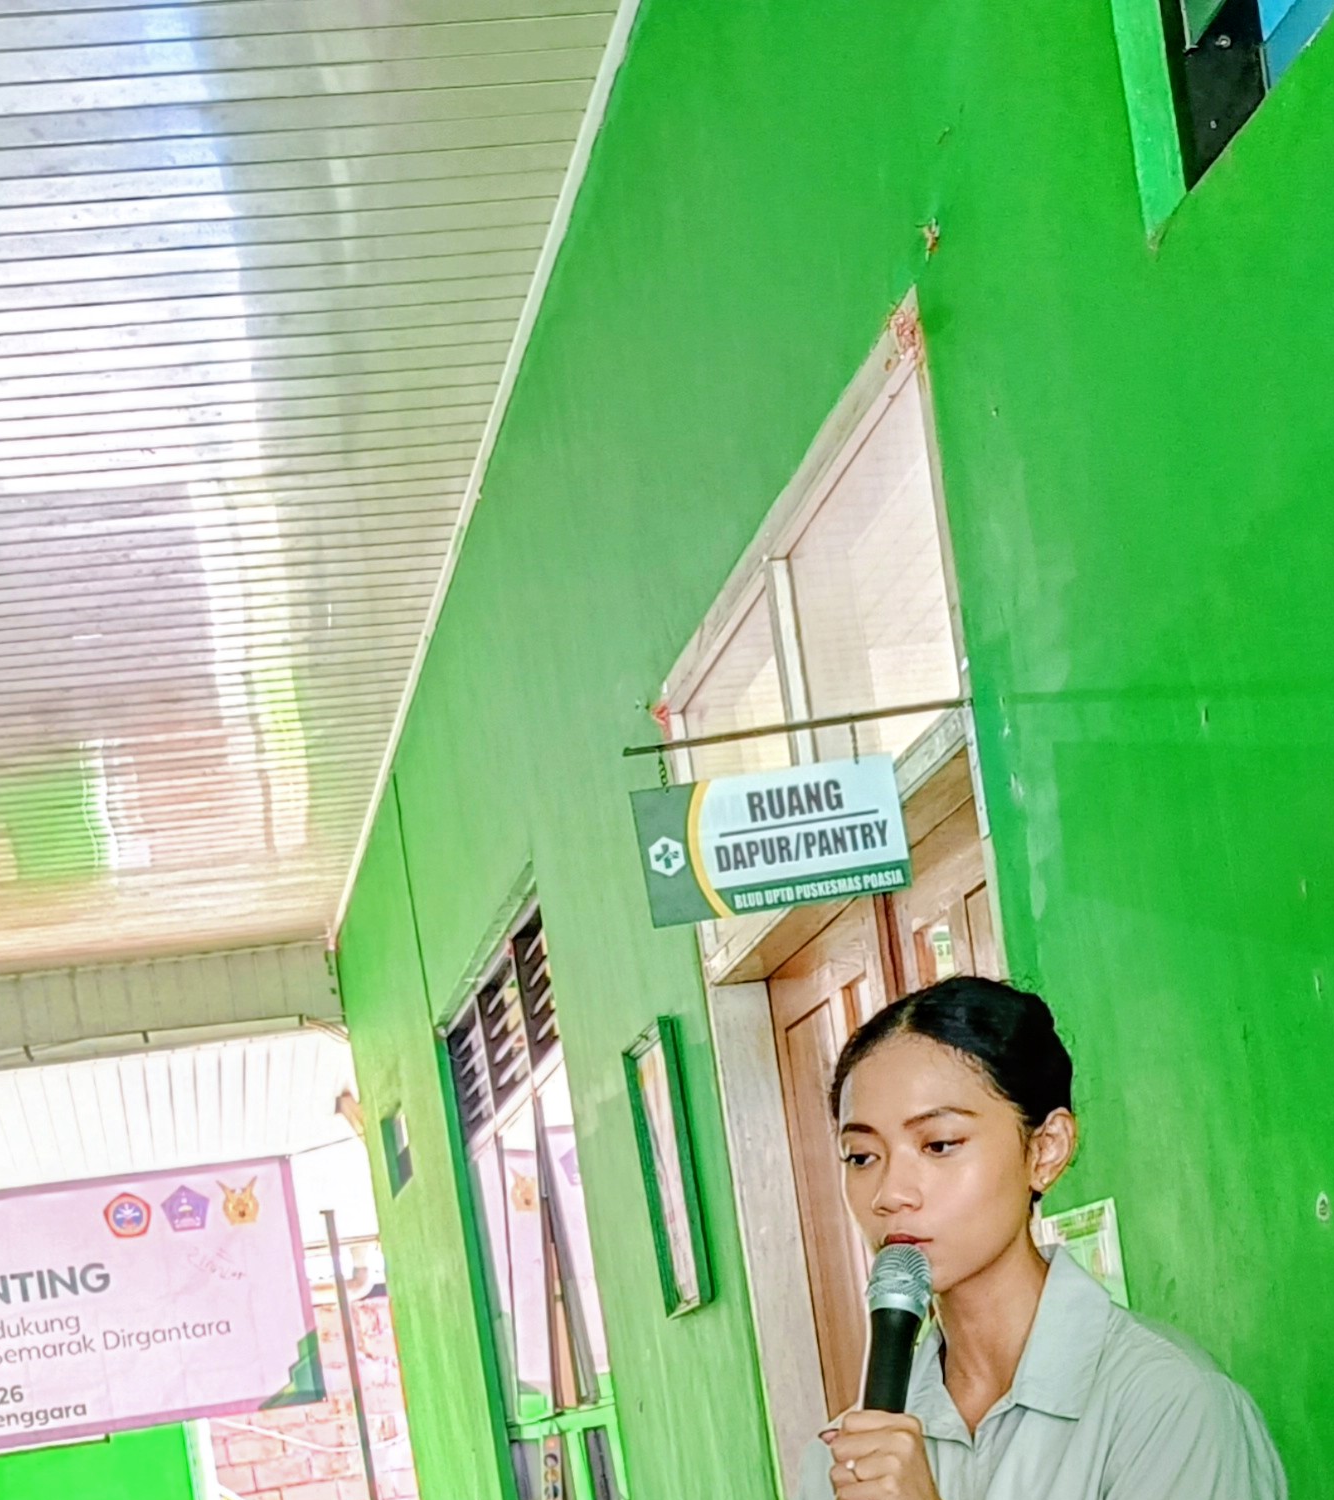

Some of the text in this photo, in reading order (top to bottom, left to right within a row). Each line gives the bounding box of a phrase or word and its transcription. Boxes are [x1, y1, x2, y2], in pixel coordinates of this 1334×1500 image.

[746, 779, 844, 823] RUANG
[715, 819, 889, 873] DAPUR/PANTRY
[733, 868, 905, 910] BLUD UPTD PUSKESMAS POASIA
[102, 1318, 232, 1351] Dirgantara
